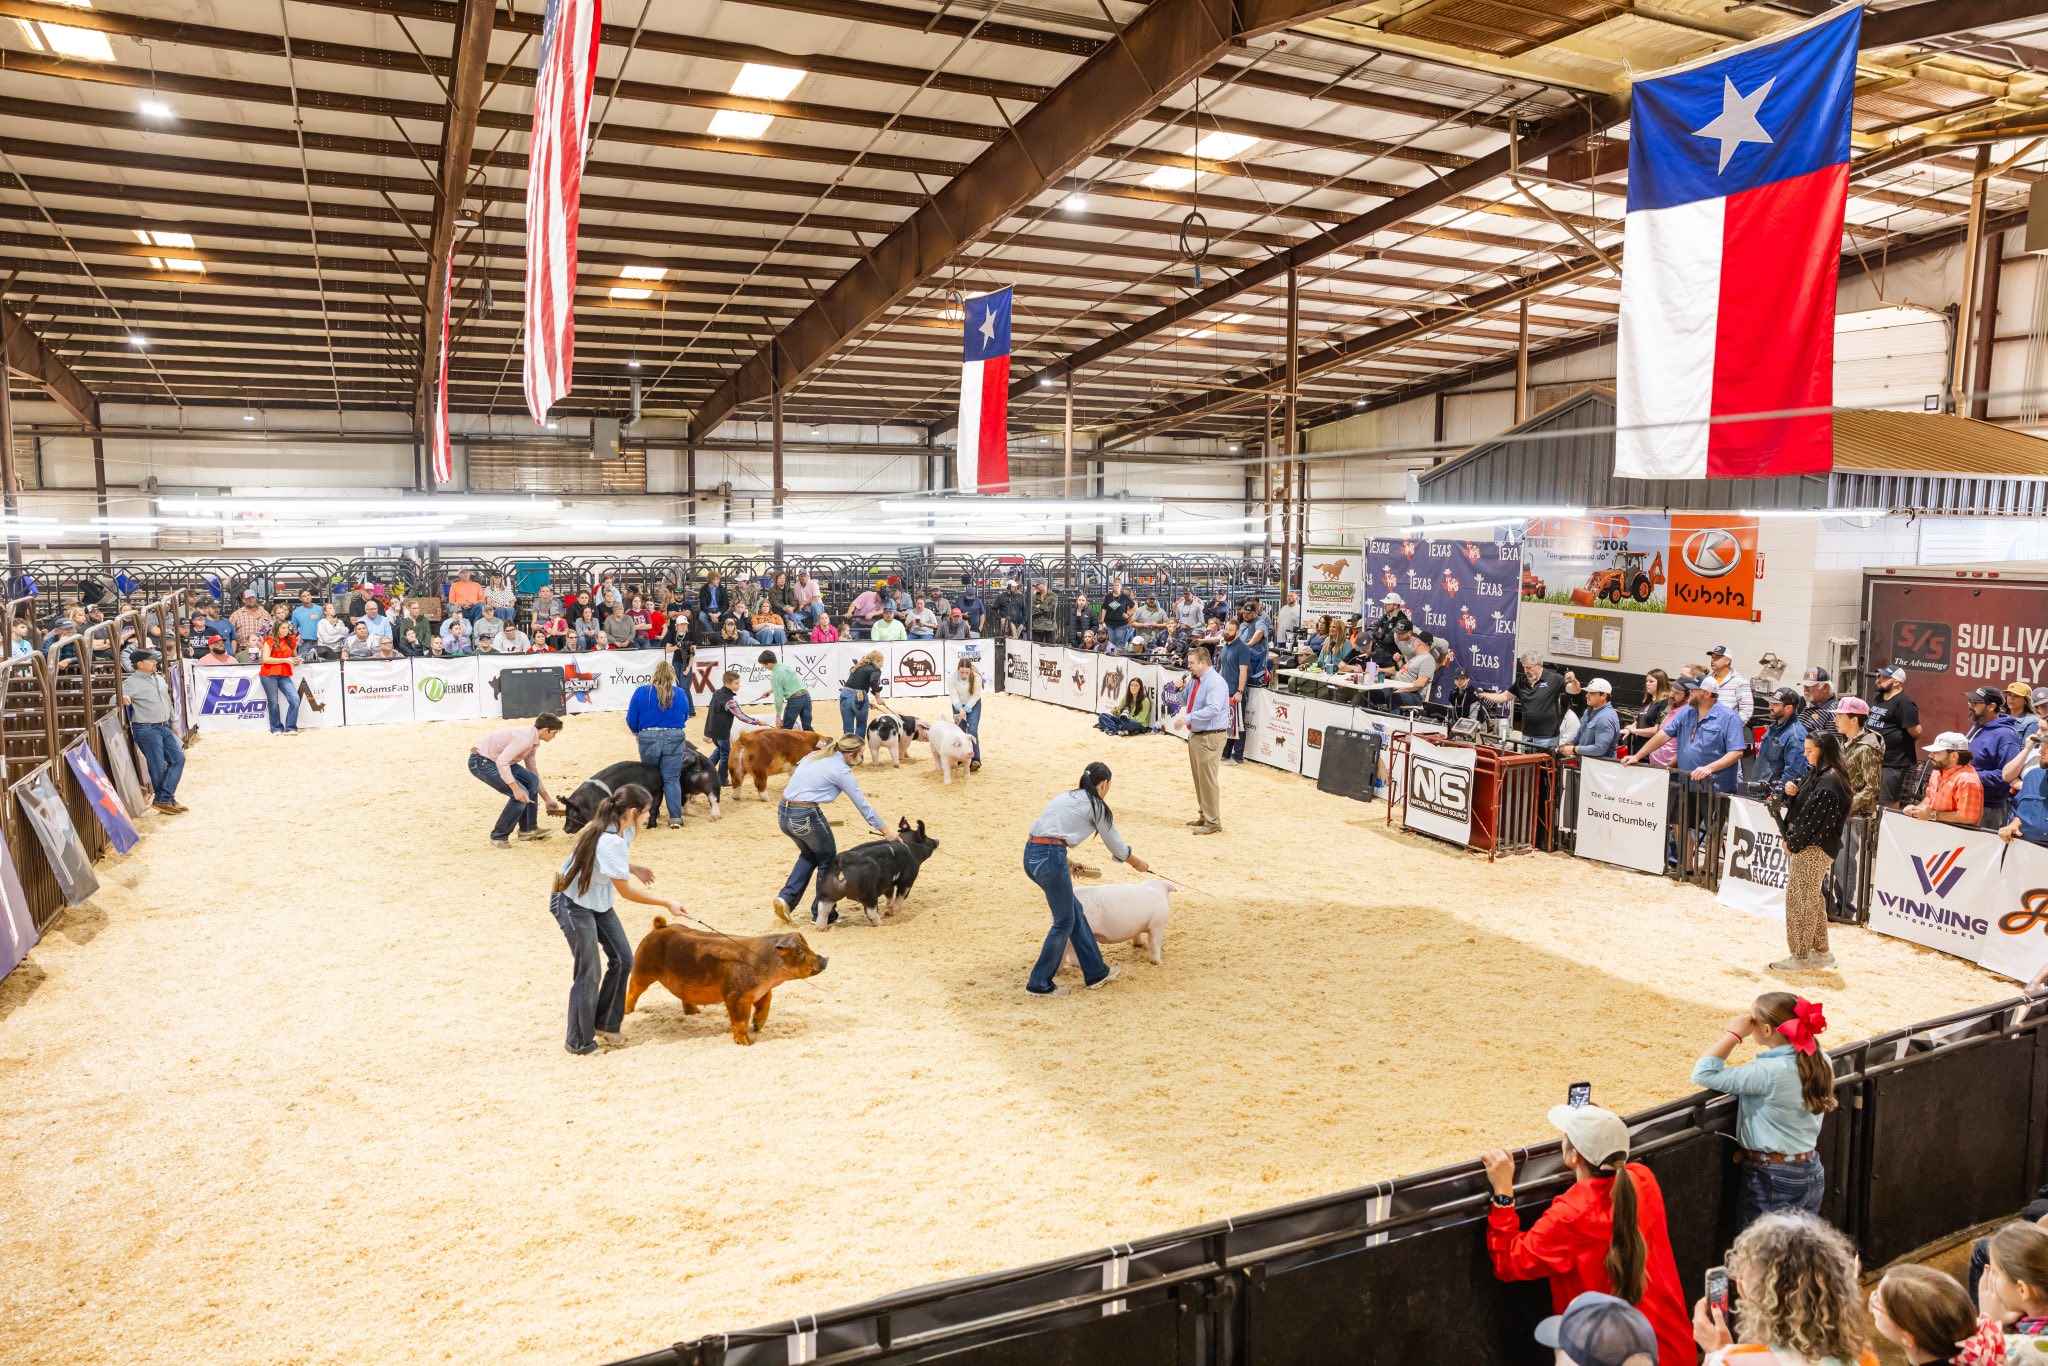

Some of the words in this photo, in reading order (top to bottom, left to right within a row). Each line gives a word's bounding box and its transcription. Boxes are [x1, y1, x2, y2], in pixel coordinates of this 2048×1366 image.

[1369, 540, 1390, 555] TEXAS
[1427, 541, 1452, 558] TEXAS
[1497, 543, 1520, 560] TEXA
[1527, 538, 1556, 548] TURF
[1312, 583, 1350, 591] CHAMPION
[1408, 572, 1432, 591] TEXAS
[1475, 577, 1503, 597] TEXAS
[1674, 582, 1745, 607] Kubota
[1423, 608, 1447, 627] TEXAS
[1491, 613, 1515, 634] TEXA
[1957, 623, 2048, 655] SULLIVA
[1040, 659, 1057, 669] WEST
[1469, 648, 1500, 669] TEXAS
[1894, 657, 1908, 667] The
[1908, 659, 1948, 671] Advantage
[1955, 652, 2046, 684] SUPPLY
[610, 671, 651, 684] TAYLOR
[1039, 667, 1061, 678] TEXAS
[200, 677, 267, 715] PRIMO
[358, 684, 409, 694] AdamsFab
[1411, 798, 1431, 810] NATIONAL
[1431, 803, 1449, 815] TRAILER
[1448, 808, 1468, 820] SOURCE
[1618, 797, 1643, 806] Office
[1587, 807, 1610, 820] David
[1612, 813, 1658, 831] Chumbley
[1775, 834, 1783, 848] T
[1877, 890, 1989, 936] WINNING
[1888, 911, 1975, 940] ENTERPRISES
